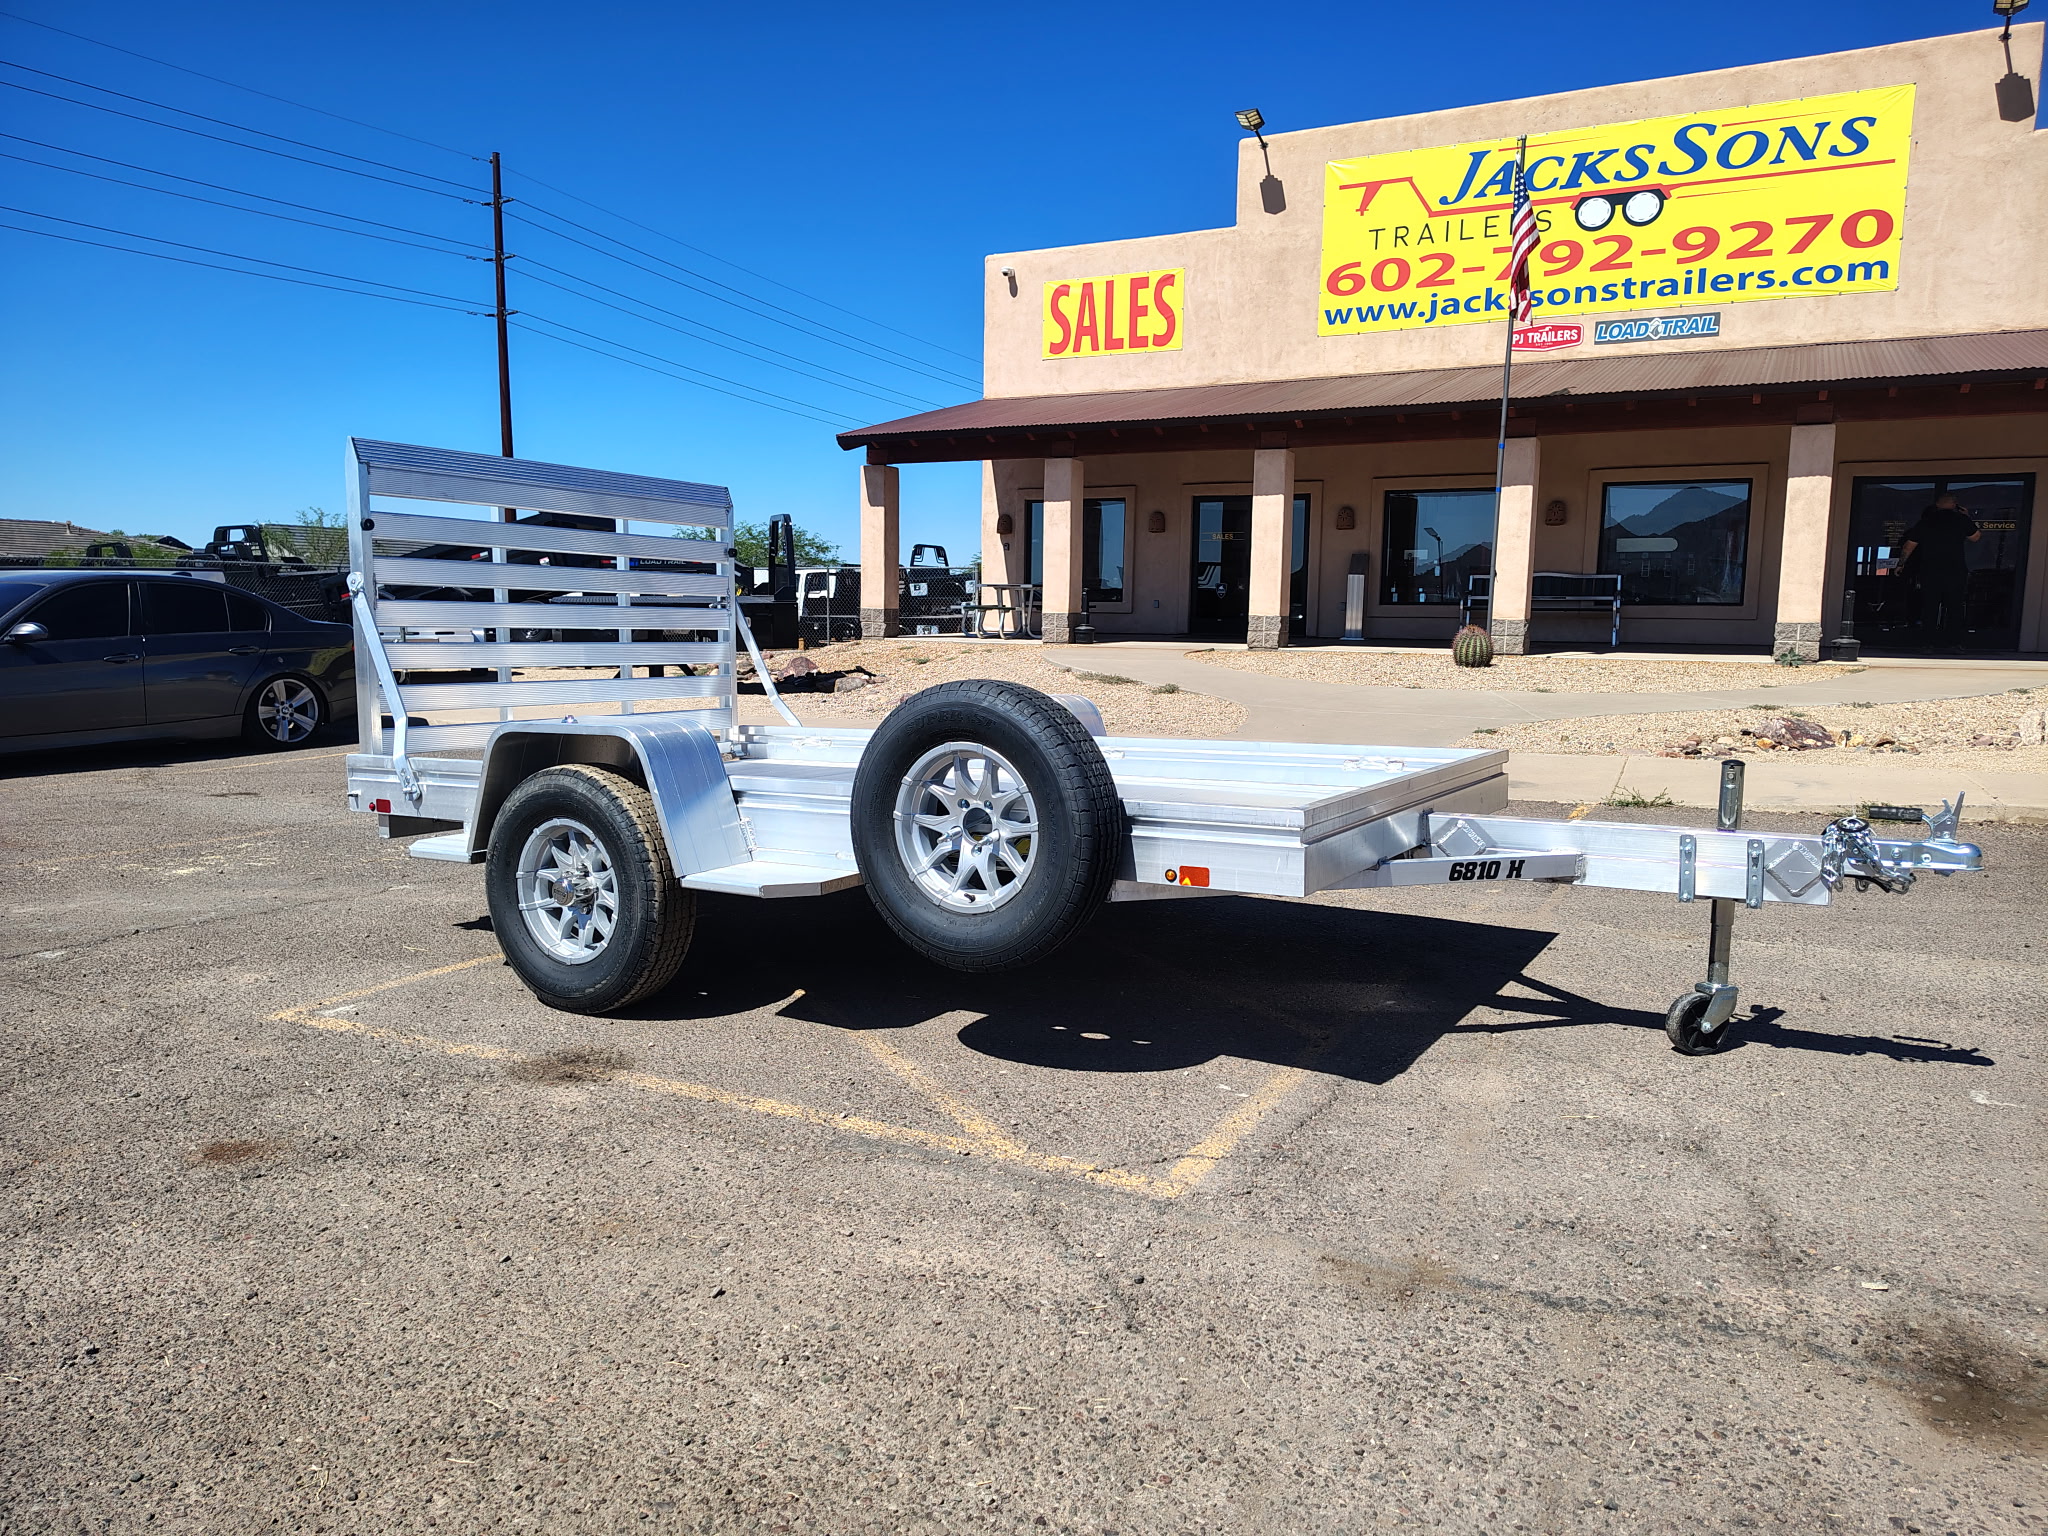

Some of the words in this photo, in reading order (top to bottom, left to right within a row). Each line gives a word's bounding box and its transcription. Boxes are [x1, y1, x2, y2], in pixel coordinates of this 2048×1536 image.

[1369, 208, 1552, 250] TRAILES
[1324, 260, 1889, 326] www.jacksonstrailers.com
[1049, 273, 1176, 355] SALES
[1512, 333, 1524, 345] PJ
[1527, 329, 1578, 343] TRAILERS
[1596, 322, 1650, 341] LOAD
[1660, 315, 1719, 336] TRAIL
[1982, 521, 2016, 529] Service
[1448, 861, 1502, 882] 6810
[1505, 859, 1526, 879] H
